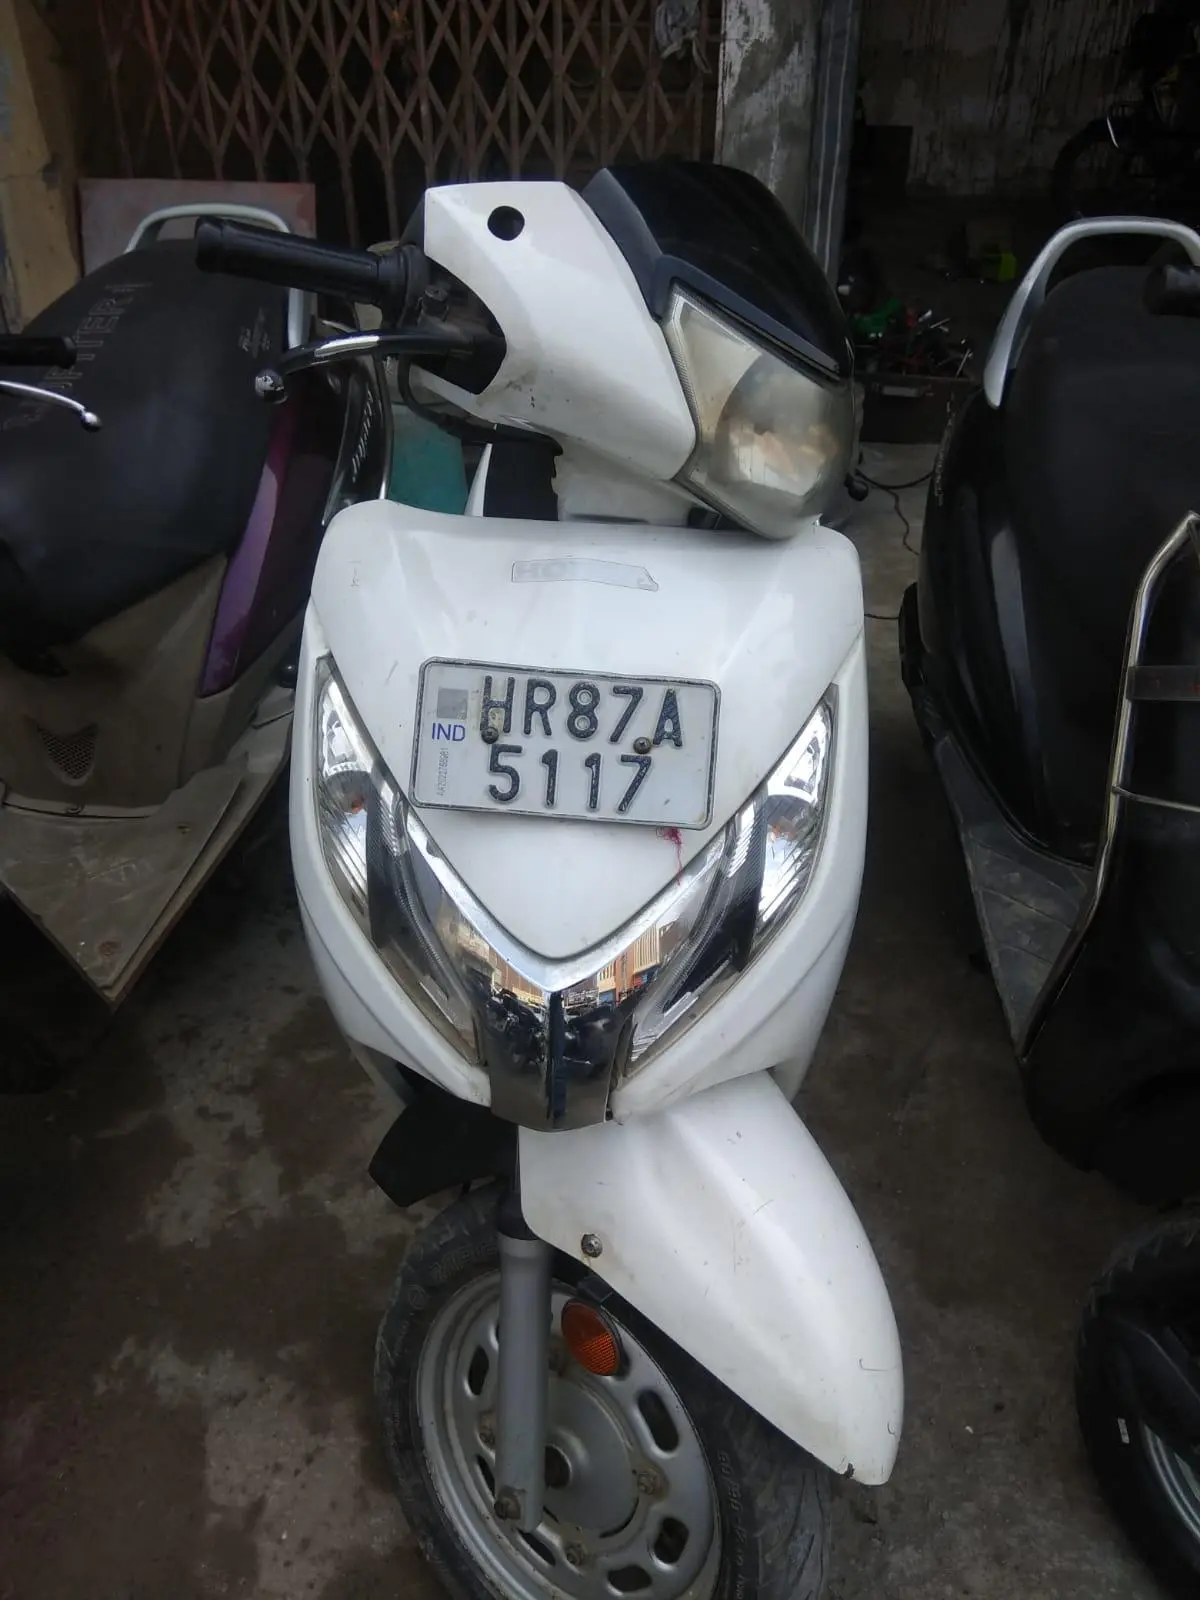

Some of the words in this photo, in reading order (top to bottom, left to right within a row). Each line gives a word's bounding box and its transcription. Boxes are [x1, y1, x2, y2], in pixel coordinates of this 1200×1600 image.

[431, 722, 466, 741] IND
[480, 675, 683, 747] HR87A
[488, 744, 652, 813] 5117
